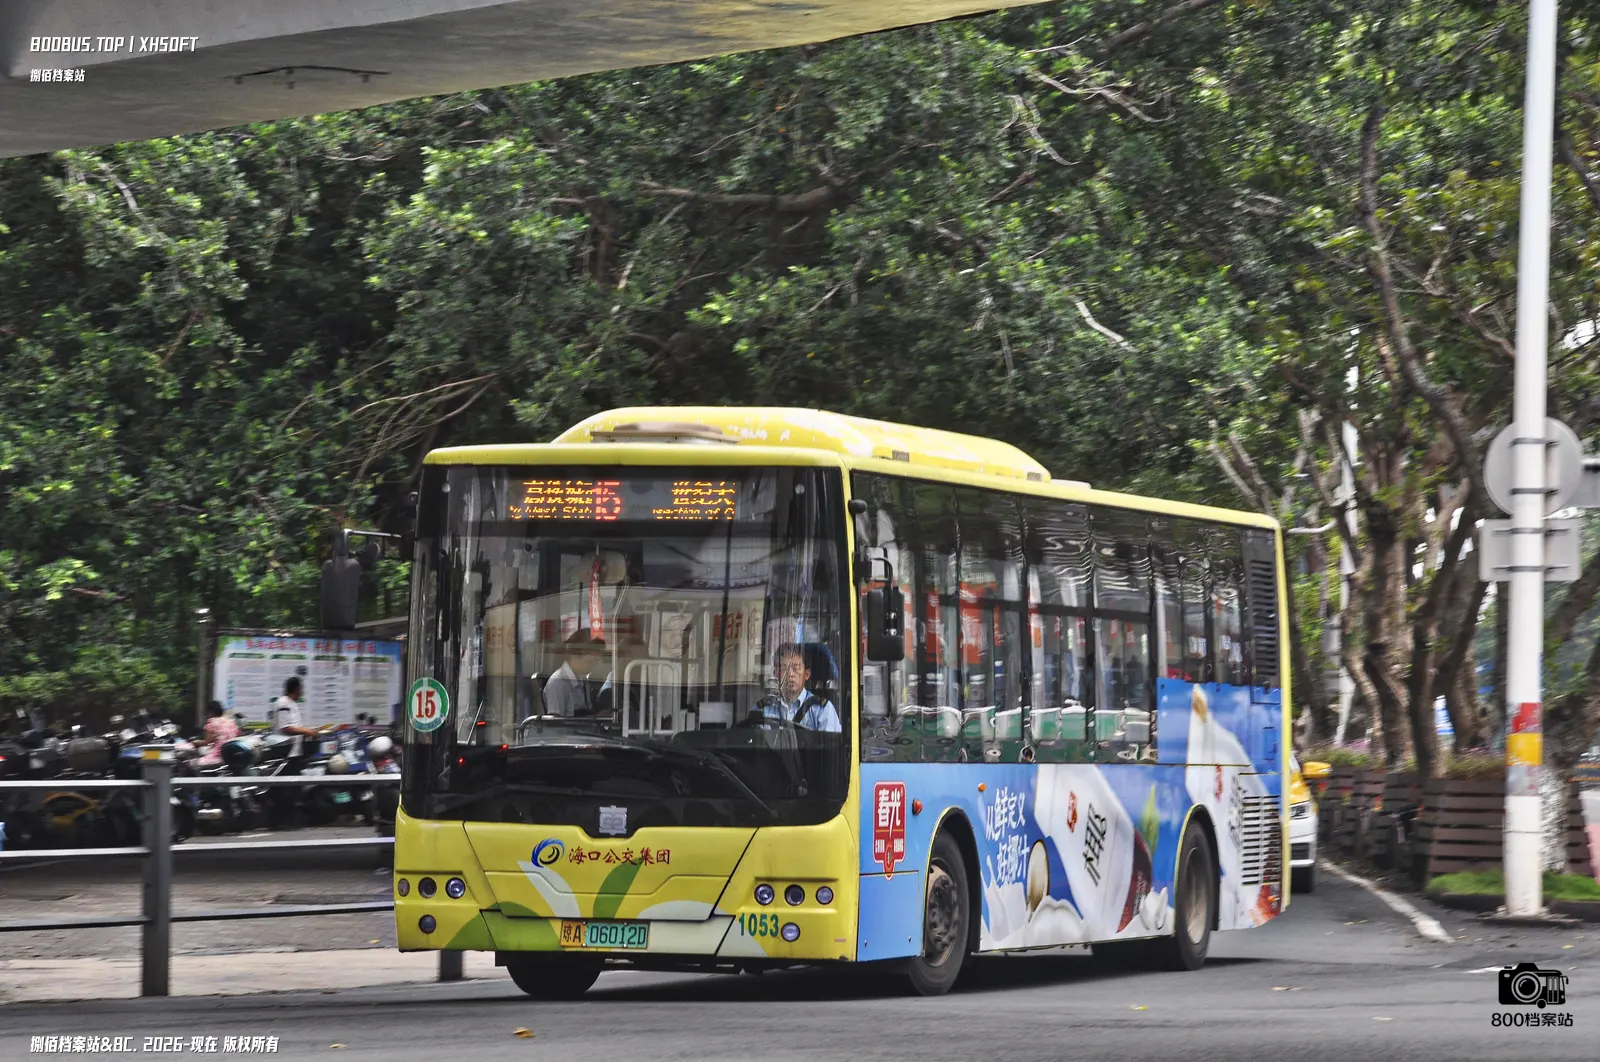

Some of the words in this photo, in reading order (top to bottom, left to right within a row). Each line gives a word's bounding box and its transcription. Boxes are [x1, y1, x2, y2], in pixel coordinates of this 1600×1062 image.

[415, 690, 437, 719] 15
[877, 788, 902, 839] 春光
[568, 846, 672, 866] 海口公交集团
[738, 913, 780, 937] 1053
